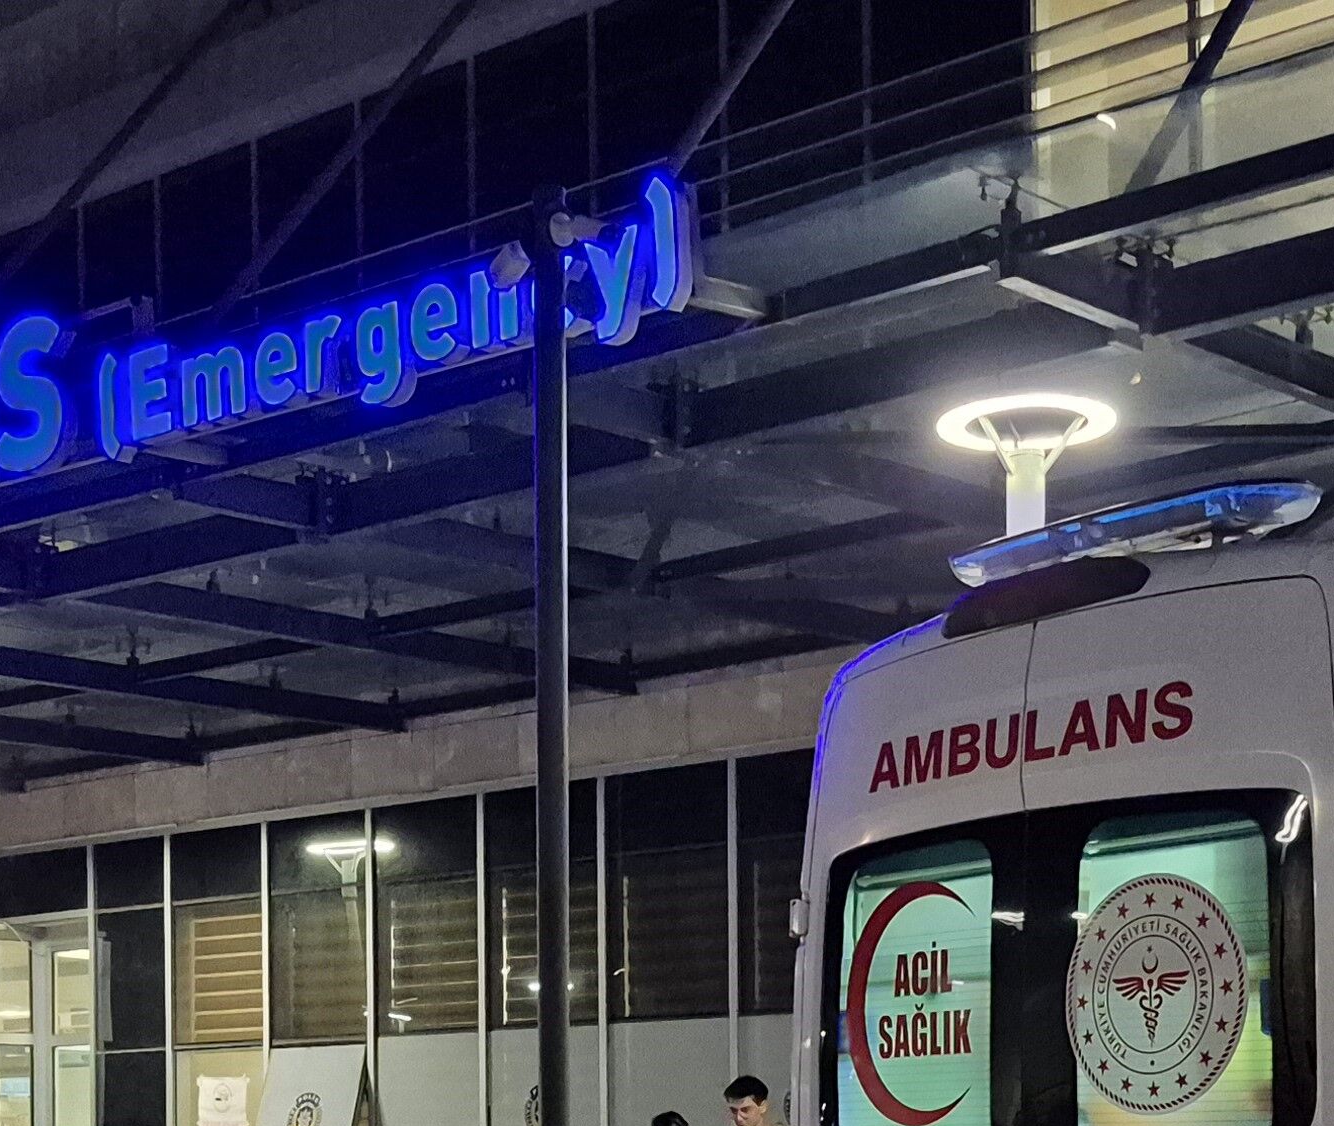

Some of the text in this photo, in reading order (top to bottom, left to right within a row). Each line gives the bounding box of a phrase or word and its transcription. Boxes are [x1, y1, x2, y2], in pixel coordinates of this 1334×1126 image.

[97, 176, 677, 460] (Emergeny)
[868, 681, 1194, 793] AMBULANS
[894, 941, 951, 997] ACİL
[1096, 918, 1161, 995] CUMHURİYETİ
[1165, 924, 1202, 964] SAĞLIK
[878, 1003, 972, 1059] SAĞLIK
[1177, 967, 1209, 1054] BAKANLIĞI
